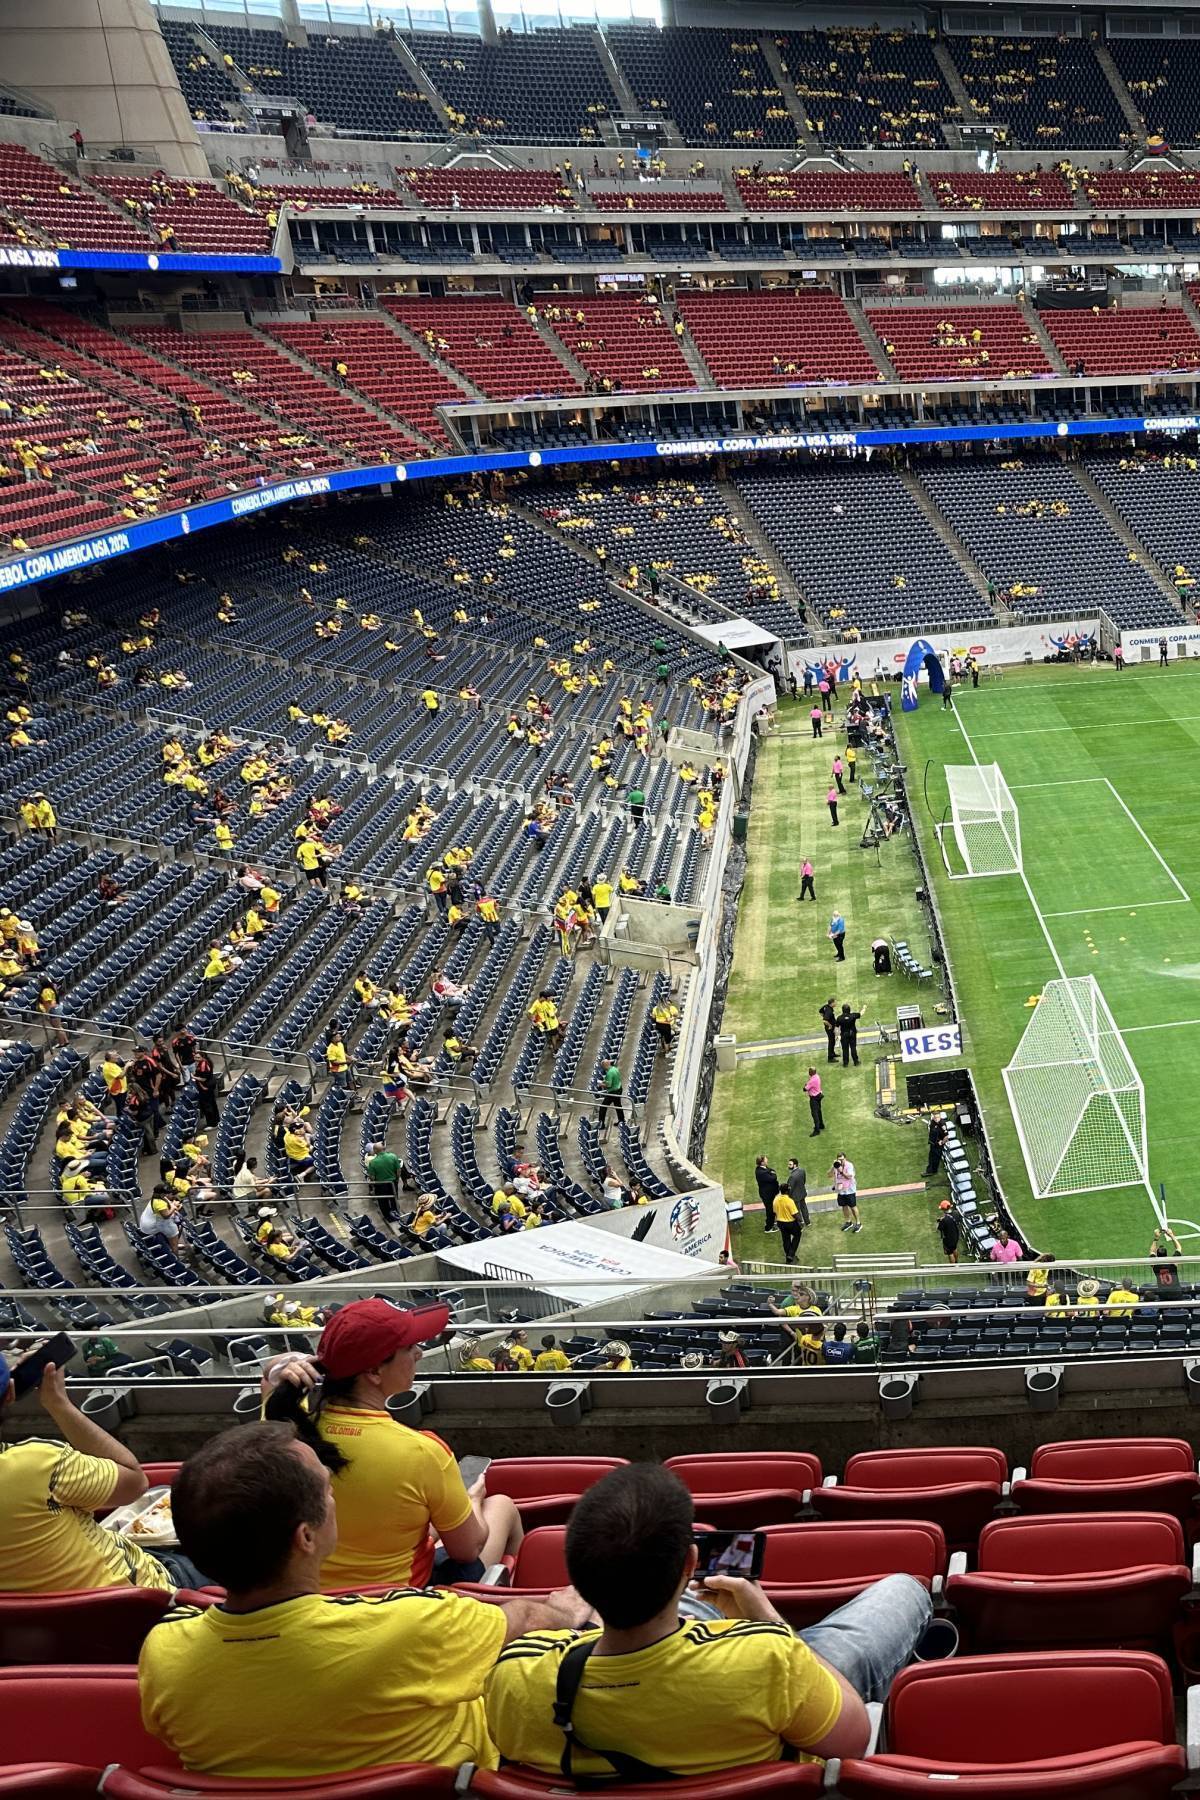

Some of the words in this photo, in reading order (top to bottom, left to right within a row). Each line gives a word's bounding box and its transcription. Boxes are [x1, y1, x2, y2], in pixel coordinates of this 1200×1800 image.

[32, 251, 60, 267] 2024
[1143, 417, 1199, 430] CONMEBOL
[656, 439, 722, 455] CONMEBOL
[722, 438, 754, 451] COPA
[754, 435, 806, 449] AMERICA
[806, 434, 829, 446] USA
[829, 433, 857, 445] 2024
[231, 493, 262, 515] CONMEBOL
[260, 489, 275, 506] COPA
[274, 483, 296, 502] AMERICA
[294, 480, 313, 496] USA
[310, 477, 331, 493] 2024
[26, 553, 54, 579] COPA
[52, 542, 95, 570] AMERICA
[92, 537, 111, 559] USA
[108, 532, 130, 553] 2024
[1168, 634, 1188, 642] COPA
[900, 1032, 961, 1056] RESS
[684, 1233, 713, 1255] AMERICA
[539, 1245, 598, 1264] AMERICA
[596, 1263, 632, 1275] COPA
[326, 1423, 362, 1436] COLOMBIA
